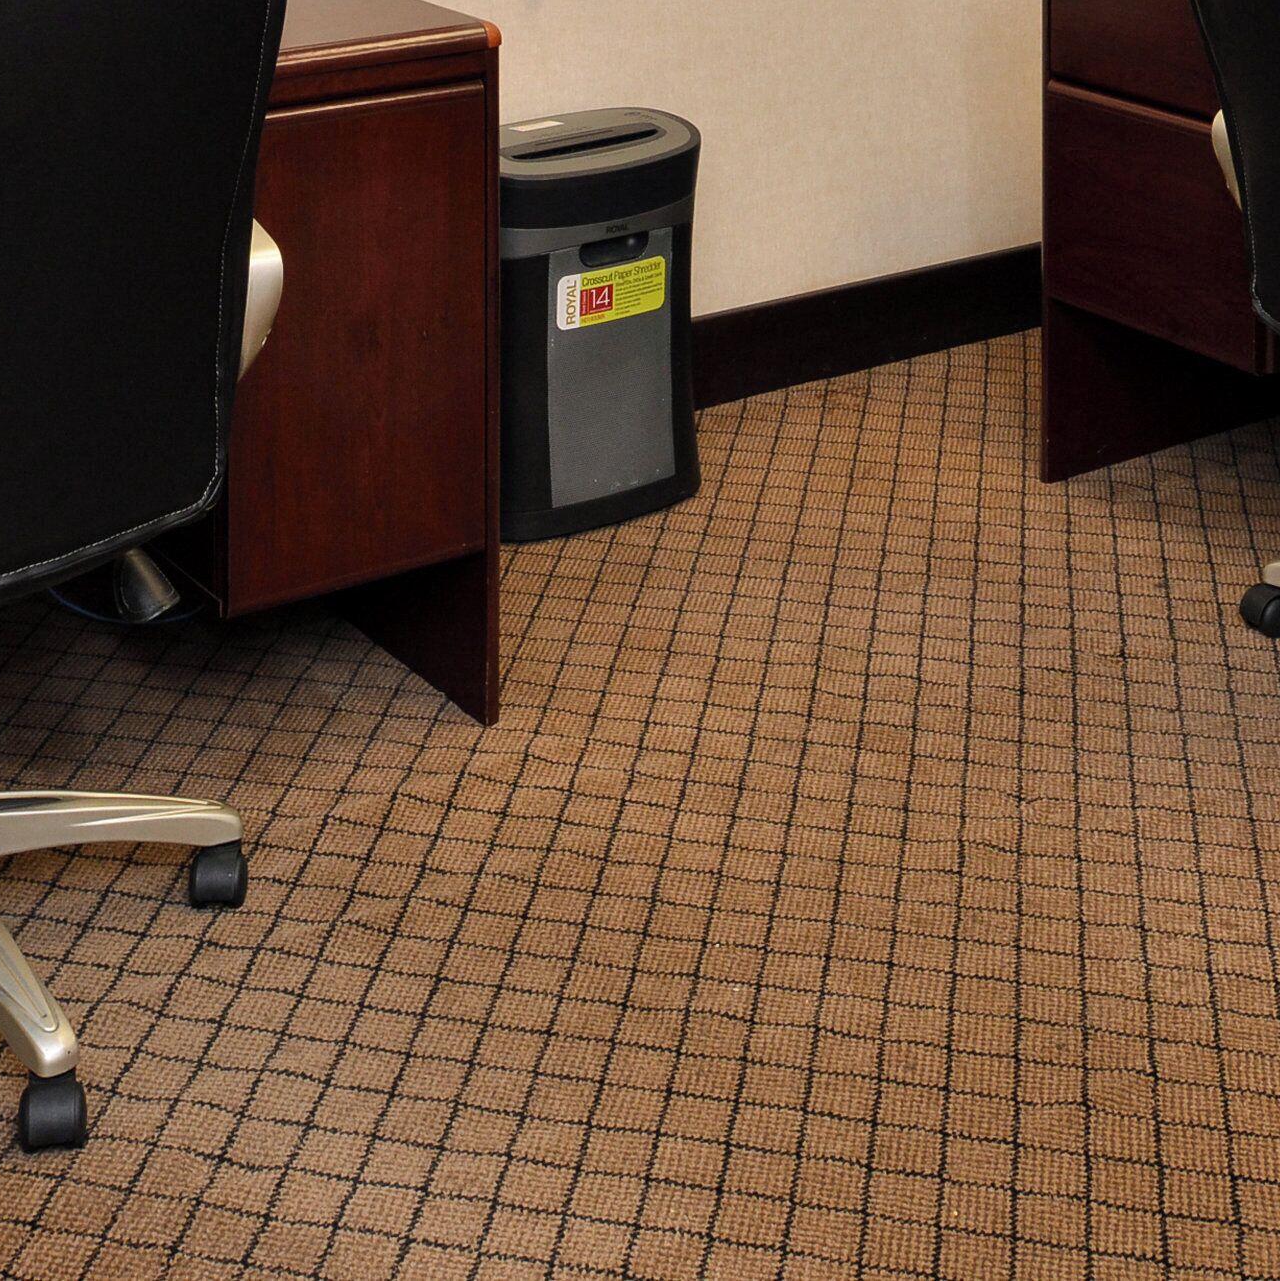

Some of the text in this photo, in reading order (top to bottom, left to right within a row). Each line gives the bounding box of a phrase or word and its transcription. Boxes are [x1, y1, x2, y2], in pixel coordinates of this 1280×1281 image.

[606, 223, 630, 234] ROYAL
[581, 261, 662, 287] Crosscut Paper Shredder
[565, 280, 577, 326] ROYAL
[589, 286, 611, 309] 14
